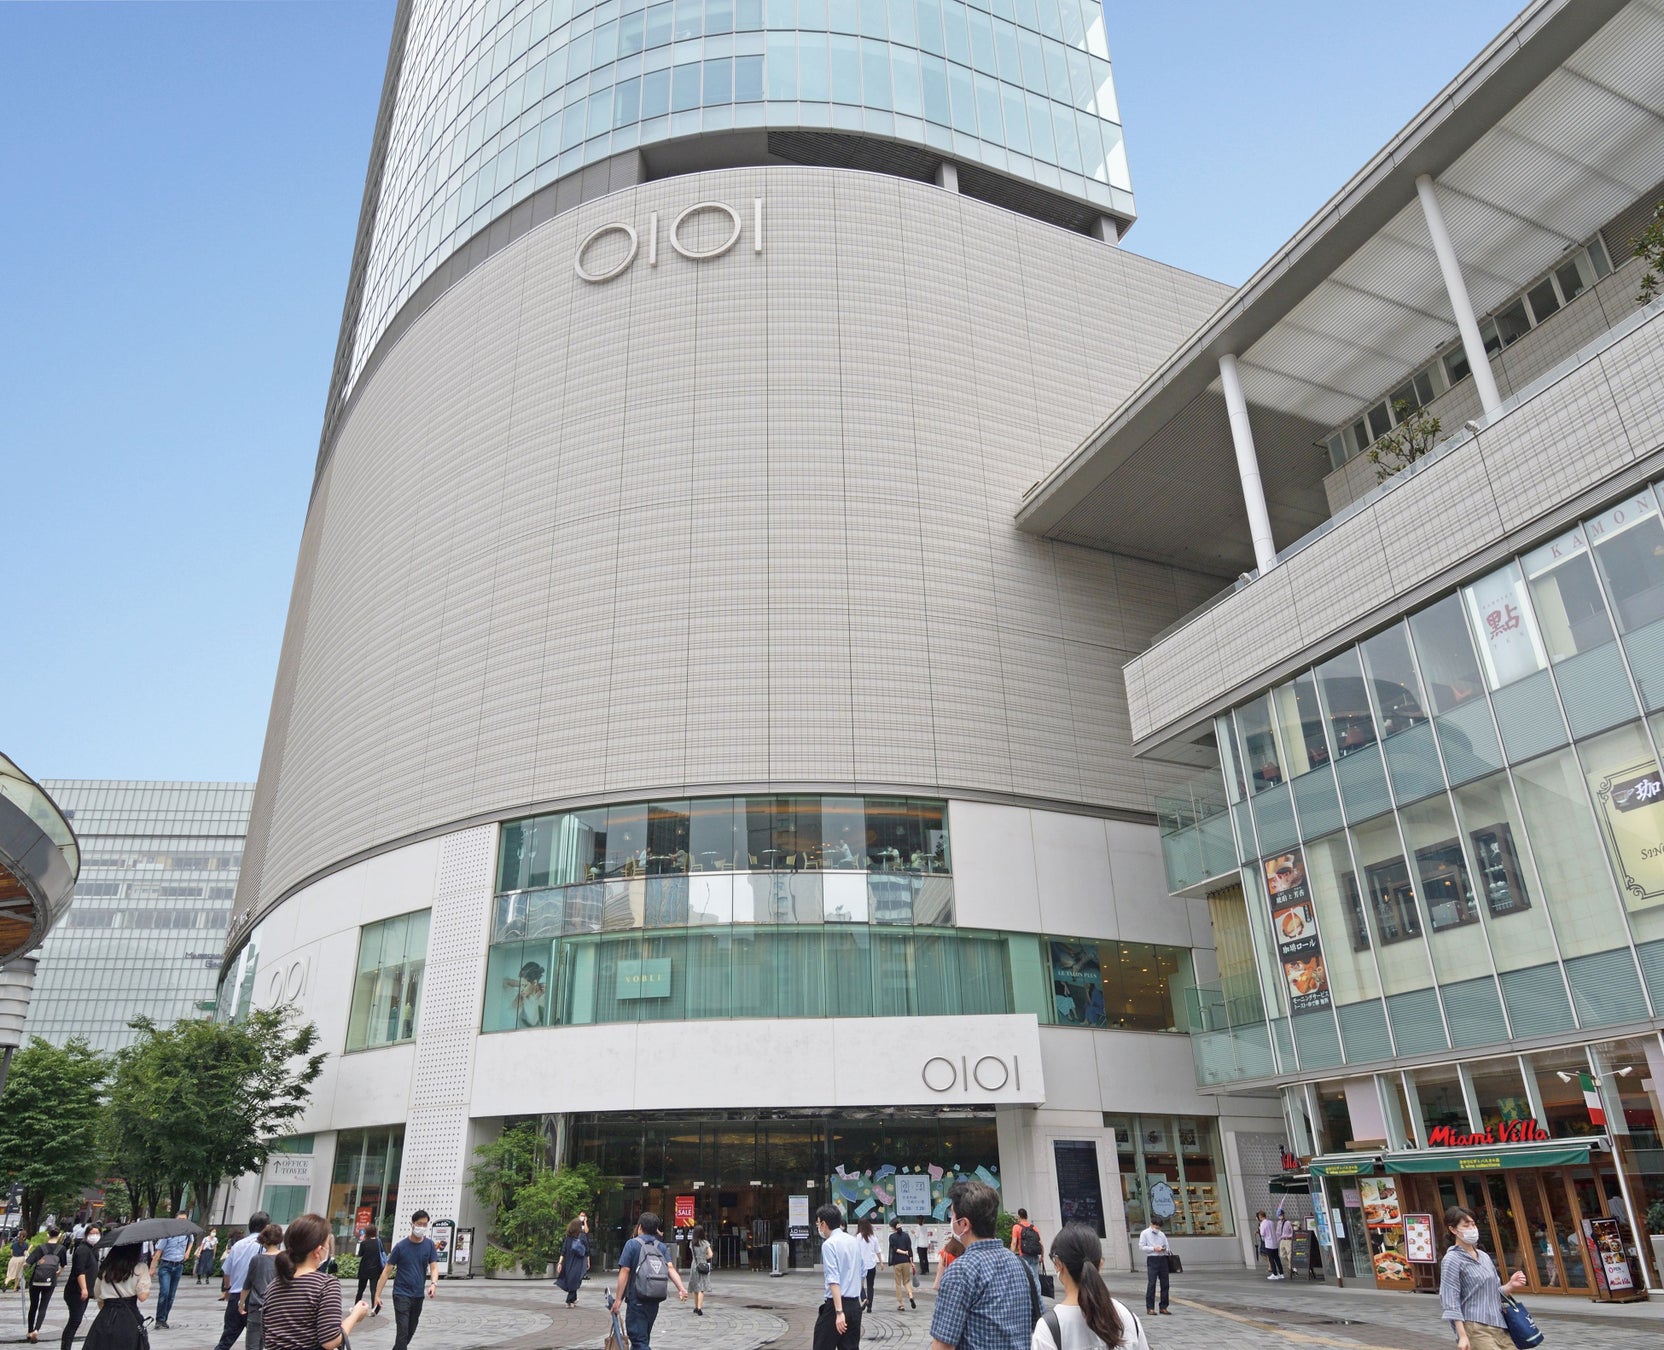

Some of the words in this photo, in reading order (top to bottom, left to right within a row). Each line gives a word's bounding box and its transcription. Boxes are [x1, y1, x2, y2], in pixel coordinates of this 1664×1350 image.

[1486, 603, 1520, 640] 點
[1428, 1125, 1495, 1147] Miami
[1498, 1118, 1550, 1143] Villa
[282, 1160, 309, 1168] OFFICE
